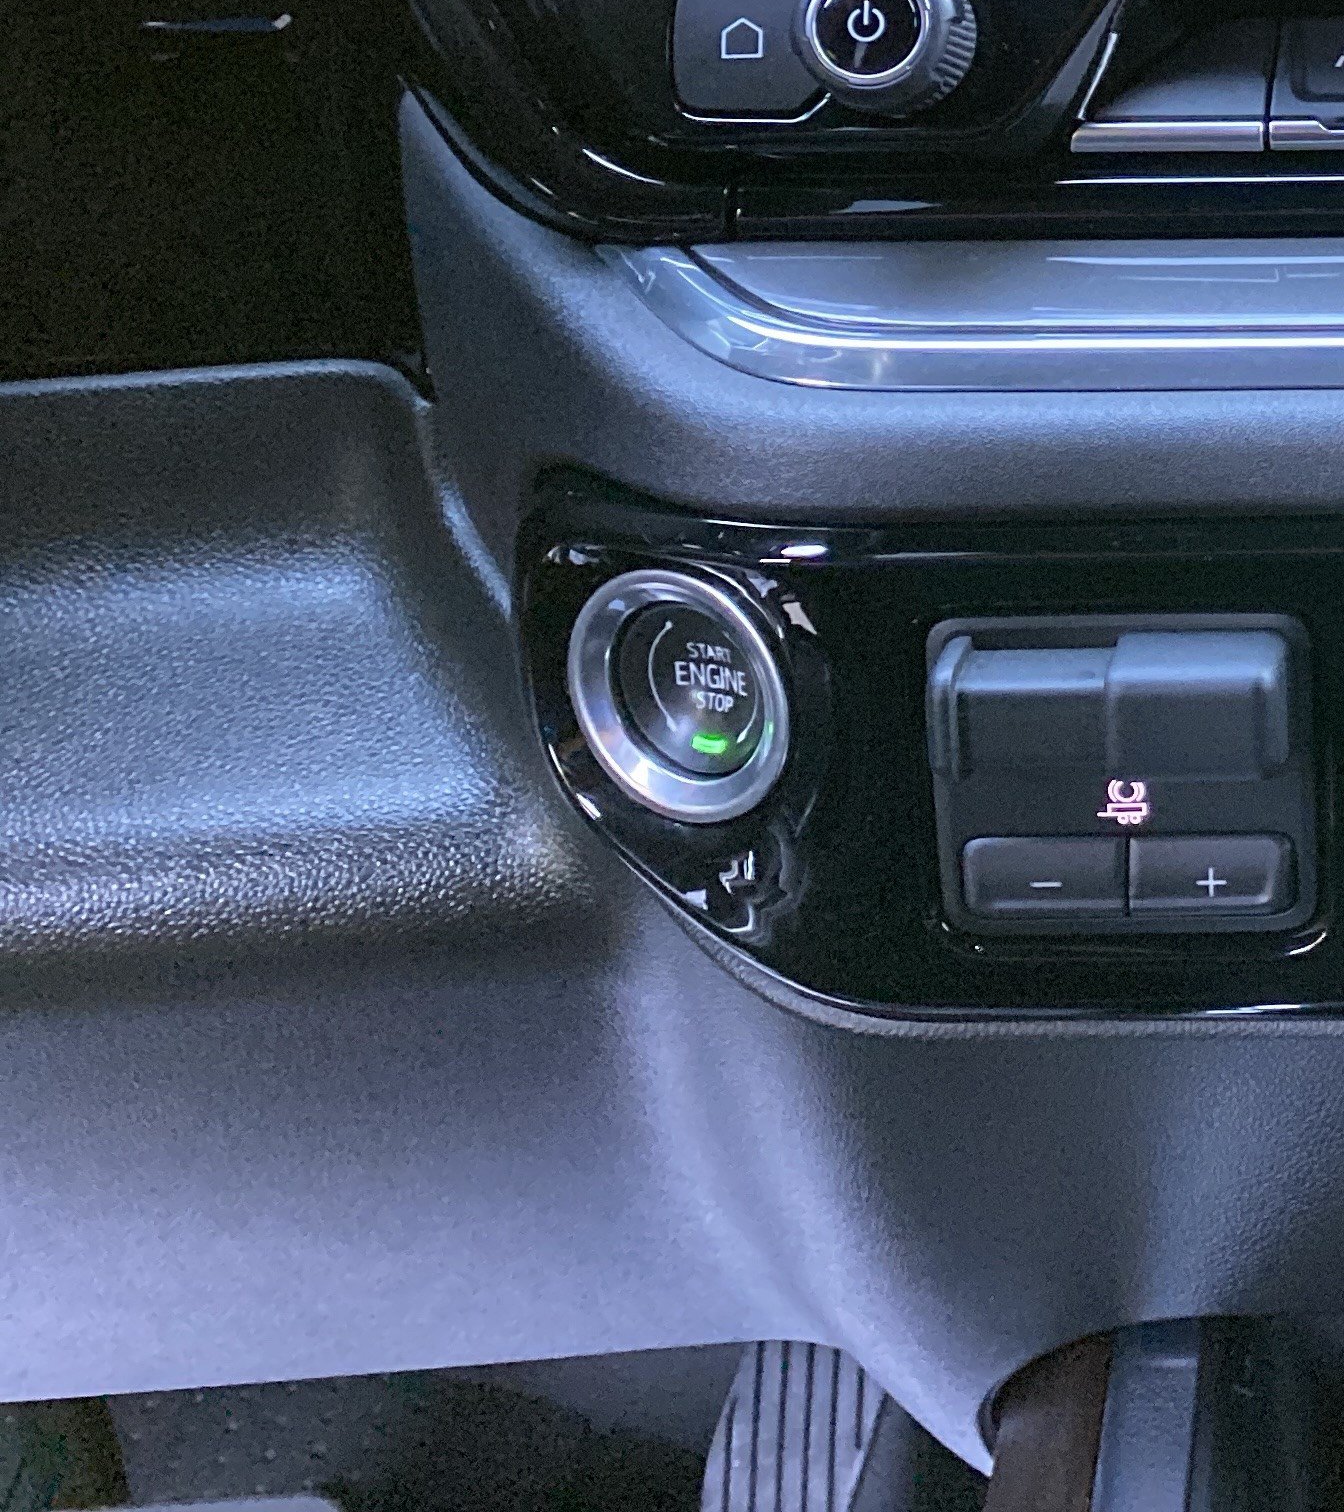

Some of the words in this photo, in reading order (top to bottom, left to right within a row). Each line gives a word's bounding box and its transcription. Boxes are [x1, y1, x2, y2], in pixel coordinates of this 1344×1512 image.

[686, 642, 732, 663] START
[674, 661, 748, 696] ENGINE
[695, 691, 733, 713] STOP
